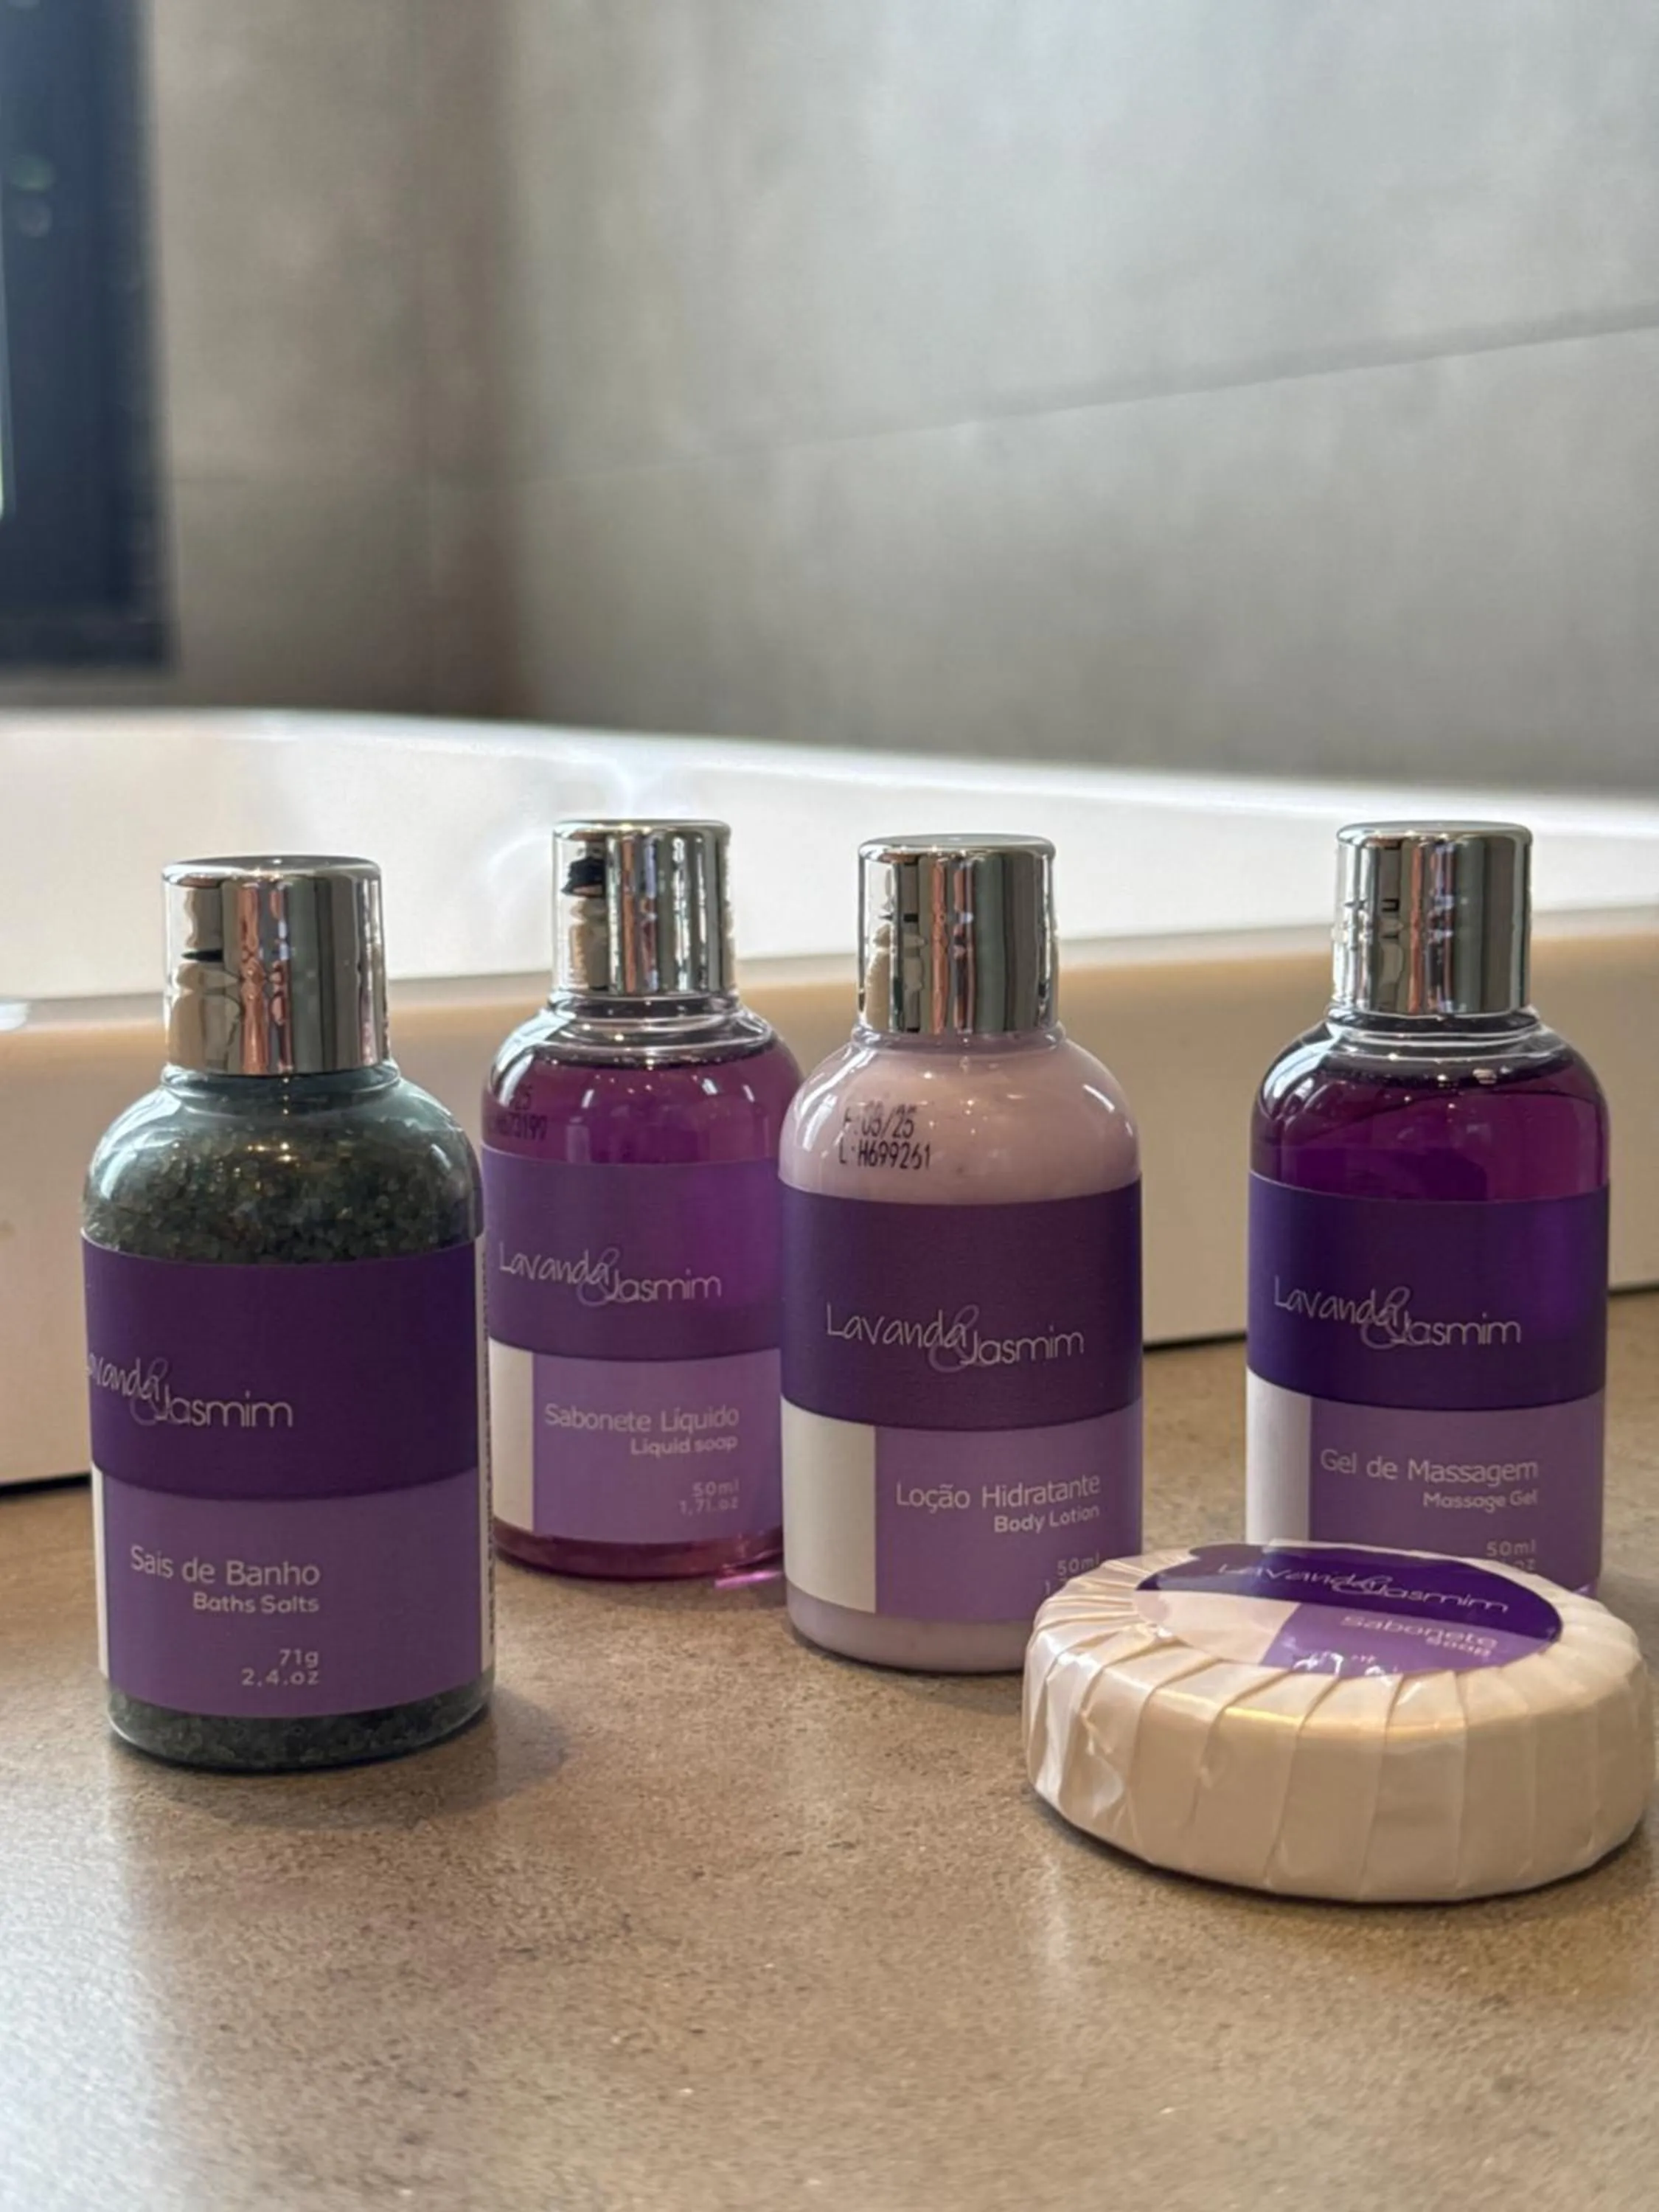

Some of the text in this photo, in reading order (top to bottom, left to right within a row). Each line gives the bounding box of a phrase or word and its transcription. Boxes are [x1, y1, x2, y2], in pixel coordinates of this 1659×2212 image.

[544, 1402, 652, 1432] Sabonete
[630, 1436, 738, 1458] Liquid soap
[1320, 1448, 1539, 1487] Gel de Massagem
[692, 1477, 740, 1498] 50ml
[896, 1474, 1101, 1514] Loção Hidratante
[1422, 1489, 1538, 1514] Massage Gel
[994, 1505, 1100, 1534] Body Lotion
[1486, 1538, 1536, 1557] 50ml
[131, 1544, 321, 1586] Sais de Banho
[192, 1591, 320, 1614] Baths Salts
[278, 1648, 319, 1669] 71g
